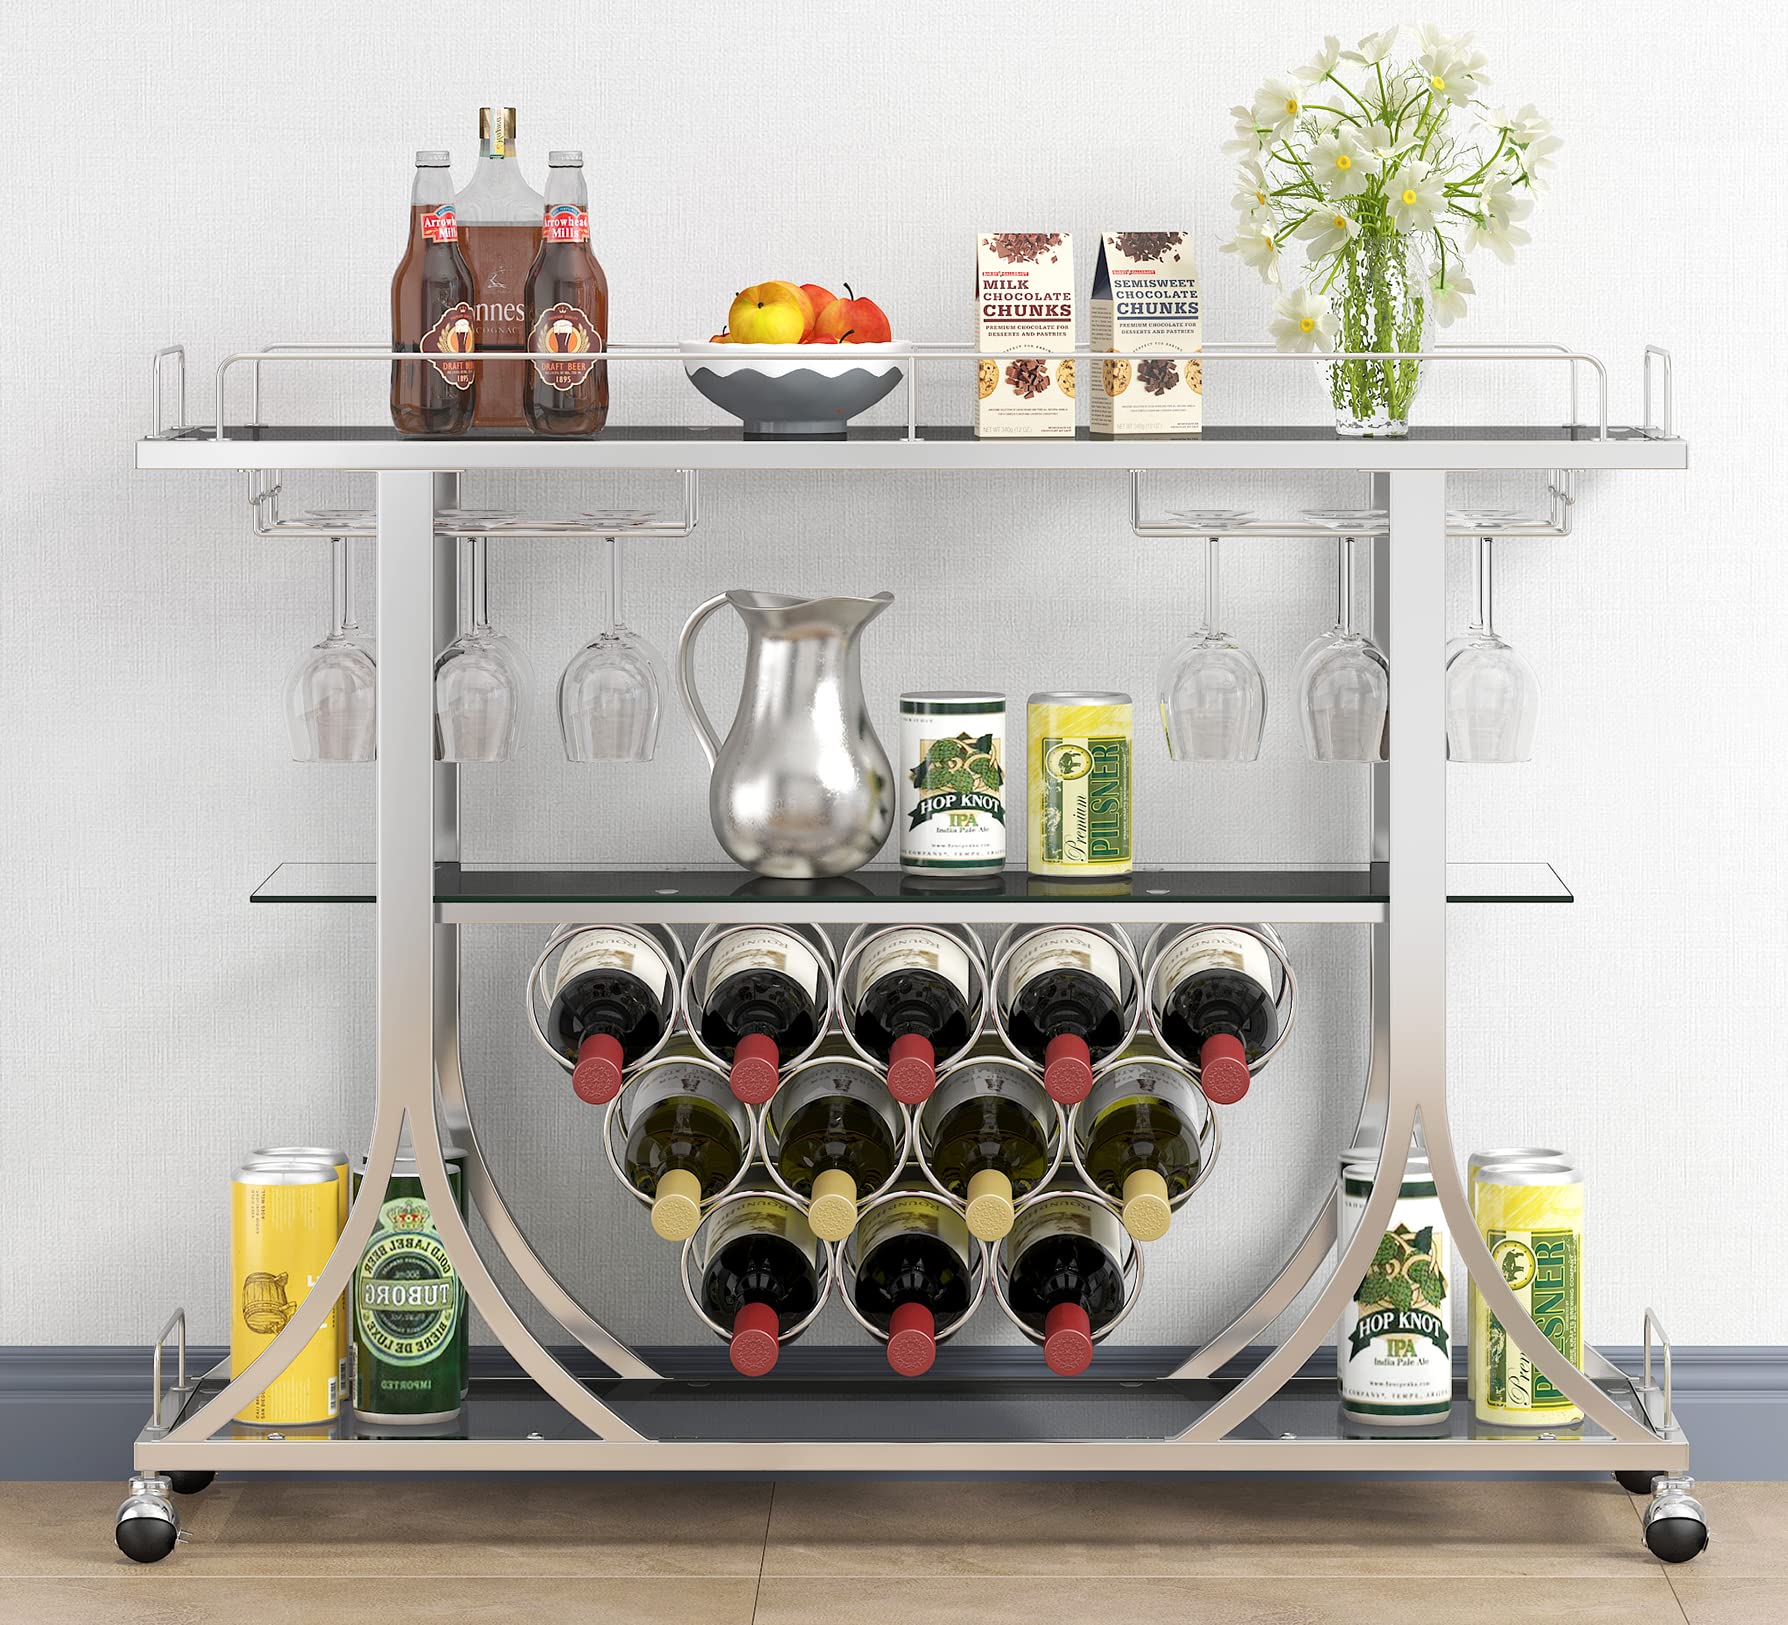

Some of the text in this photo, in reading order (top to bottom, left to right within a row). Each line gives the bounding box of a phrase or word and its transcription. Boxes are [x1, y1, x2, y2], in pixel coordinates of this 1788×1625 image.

[424, 216, 456, 228] Arrowh
[551, 227, 579, 238] Mills
[983, 280, 1029, 290] MILK
[1114, 279, 1196, 288] SEMISWEET
[983, 292, 1072, 301] CHOCOLATE
[1116, 290, 1198, 299] CHOCOLATE
[983, 304, 1072, 317] CHUNKS
[1116, 301, 1199, 315] CHUNKS
[443, 362, 463, 370] DRAFT
[542, 362, 586, 371] DRAFT BEER
[556, 375, 572, 383] 1895
[920, 793, 1000, 815] HOP KNOT
[1089, 743, 1120, 857] PILSNER
[949, 813, 979, 827] IPA
[1063, 794, 1088, 862] Premium
[1360, 1311, 1441, 1338] HOP KNOT
[1387, 1339, 1417, 1358] IPA
[1374, 1358, 1429, 1366] India Pale Ale
